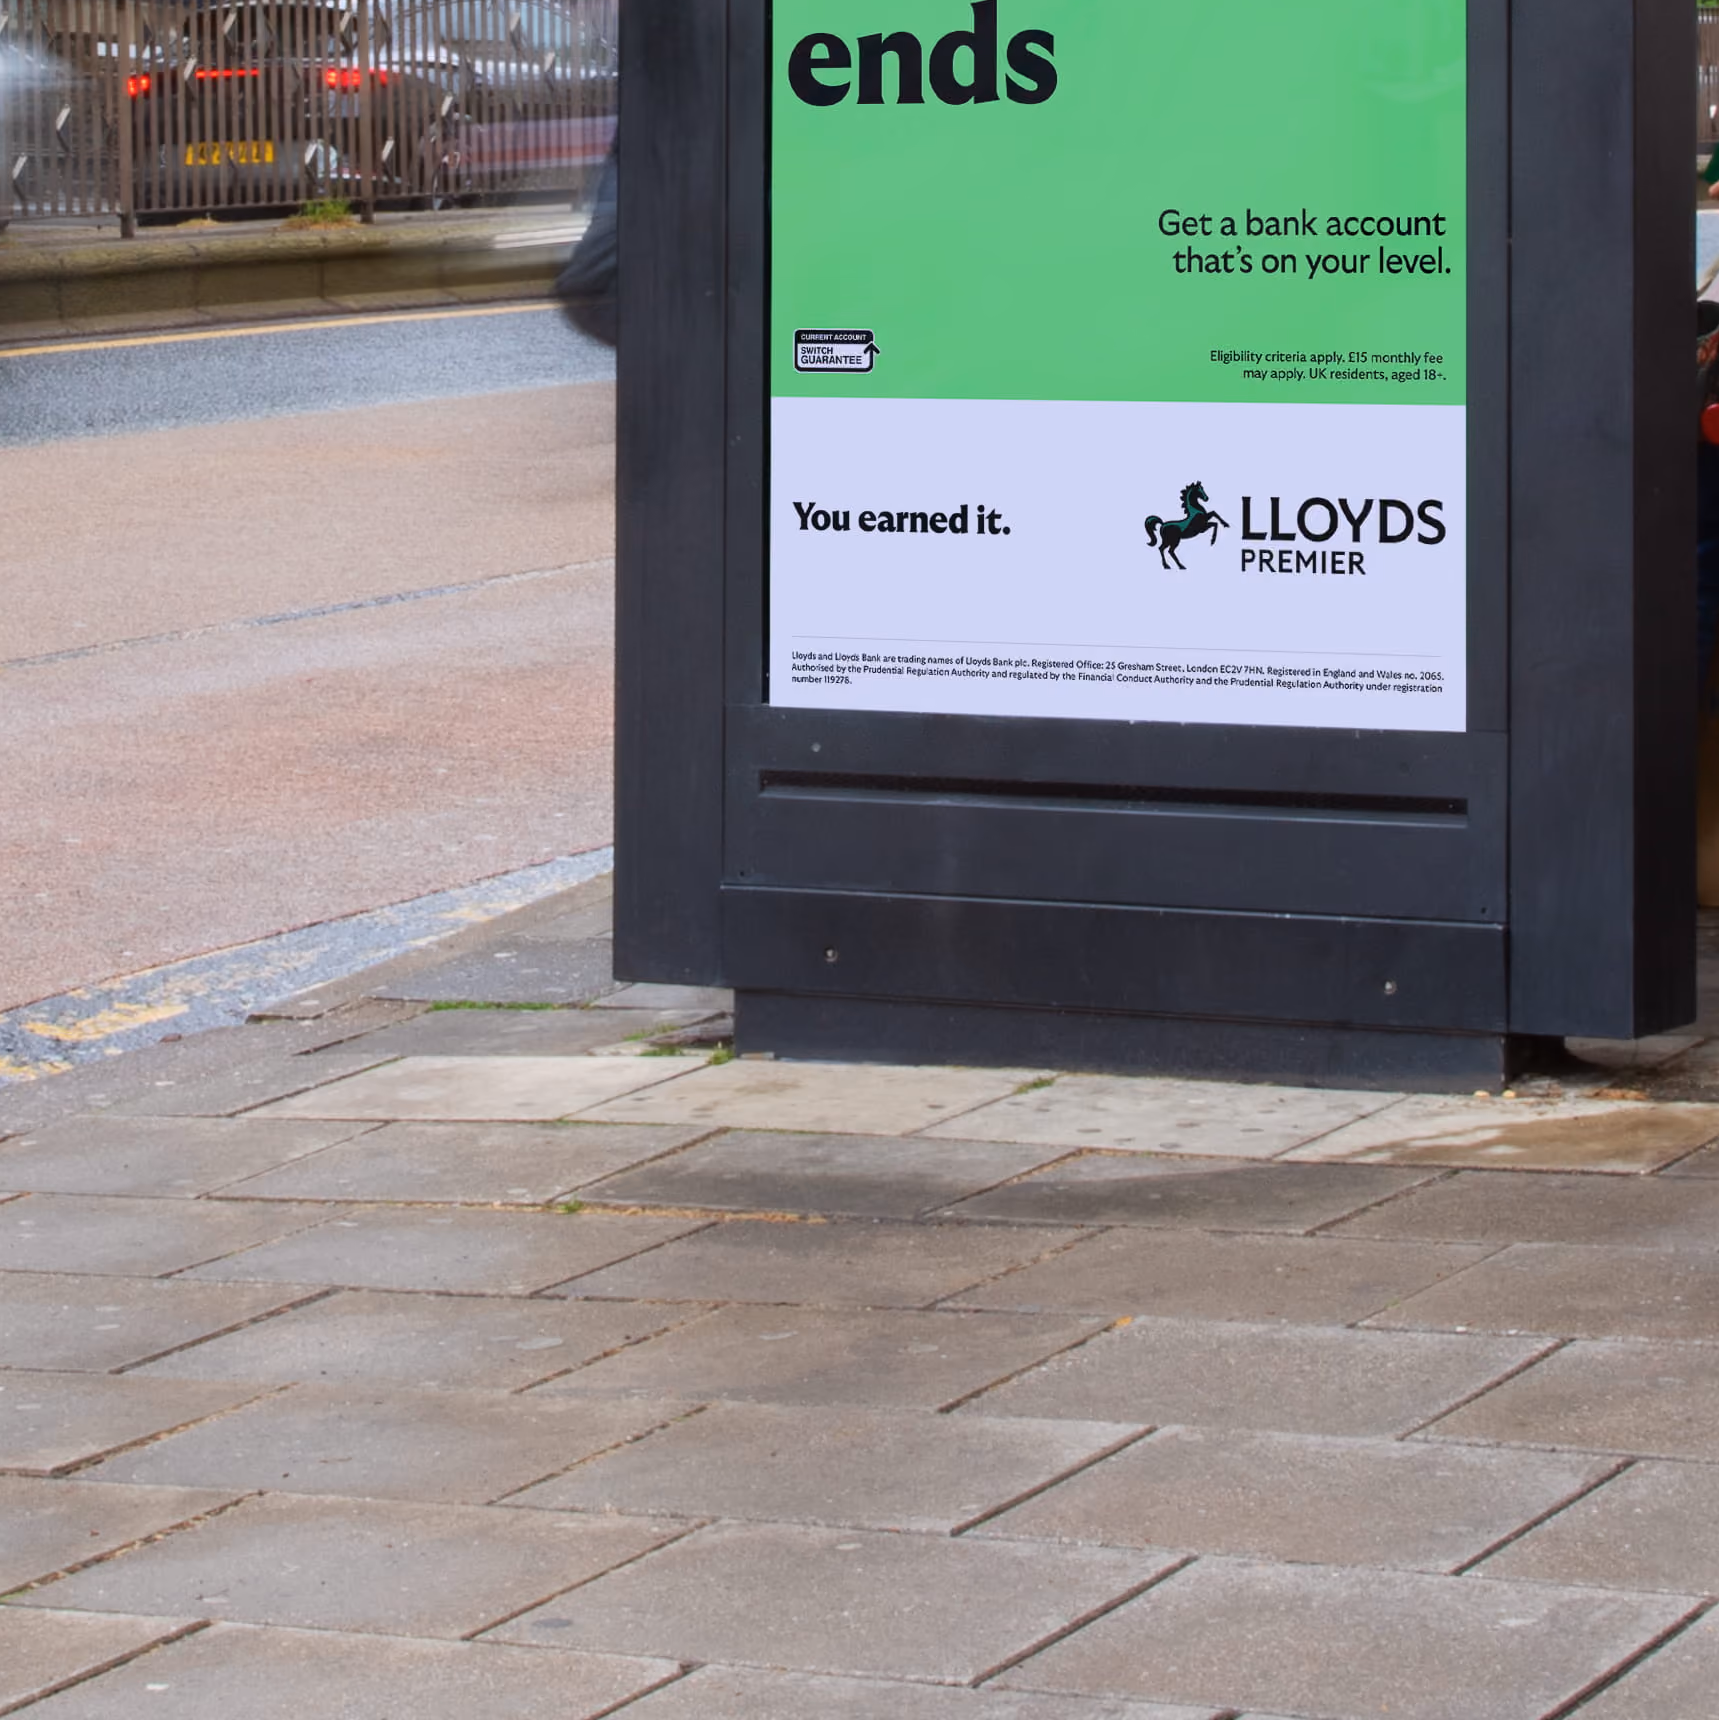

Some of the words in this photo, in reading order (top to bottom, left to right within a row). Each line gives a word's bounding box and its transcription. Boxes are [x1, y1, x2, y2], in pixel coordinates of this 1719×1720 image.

[1159, 209, 1213, 237] Get
[1221, 216, 1238, 237] a
[1246, 208, 1318, 237] bank
[1326, 212, 1447, 237] account
[1172, 245, 1253, 274] that’s
[1261, 254, 1297, 274] on
[1305, 254, 1371, 280] your
[1379, 245, 1452, 275] level.
[801, 346, 834, 355] SWITCH
[801, 355, 863, 365] GUARANTEE
[1210, 350, 1263, 365] Eligibility
[1265, 351, 1307, 363] criteria
[1310, 351, 1346, 366] apply.
[1348, 351, 1368, 363] £15
[1371, 351, 1422, 366] monthly
[1424, 351, 1444, 364] fee
[1243, 369, 1268, 382] may
[1270, 368, 1306, 382] apply.
[1309, 368, 1328, 380] UK
[1330, 368, 1389, 382] residents,
[1391, 368, 1421, 383] aged
[1424, 369, 1448, 381] 18+.
[793, 502, 851, 532] You
[858, 503, 969, 535] earned
[976, 505, 1011, 536] it.
[1242, 496, 1446, 546] LLOYDS
[1242, 549, 1366, 576] PREMIER
[791, 652, 816, 661] Lloyds
[834, 653, 859, 662] Lloyds
[861, 653, 880, 662] Bank
[897, 655, 926, 665] trading
[954, 656, 964, 664] of
[965, 657, 991, 667] Lloyds
[992, 658, 1013, 666] Bank
[1031, 659, 1074, 669] Registered
[1075, 660, 1103, 669] Office:
[1105, 661, 1115, 670] 25
[1116, 662, 1154, 671] Gresham
[1186, 664, 1218, 673] London
[1219, 665, 1242, 673] EC2V
[1266, 666, 1311, 676] Registered
[1312, 668, 1320, 676] in
[1322, 668, 1356, 678] England
[1358, 670, 1374, 678] and
[1376, 670, 1402, 679] Wales
[791, 663, 834, 672] Authorised
[836, 664, 846, 674] by
[847, 665, 861, 673] the
[862, 666, 904, 674] Prudential
[906, 667, 949, 676] Regulation
[950, 669, 989, 679] Authority
[991, 670, 1007, 678] and
[1008, 671, 1048, 680] regulated
[1049, 672, 1060, 681] by
[1062, 672, 1075, 680] the
[1078, 673, 1115, 681] Financial
[1115, 674, 1152, 683] Conduct
[1153, 675, 1194, 686] Authority
[1195, 677, 1212, 685] and
[1213, 677, 1228, 685] the
[1230, 678, 1273, 687] Prudential
[1275, 679, 1321, 689] Regulation
[1322, 678, 1364, 691] Authority
[1392, 683, 1442, 692] registration
[791, 675, 822, 683] number
